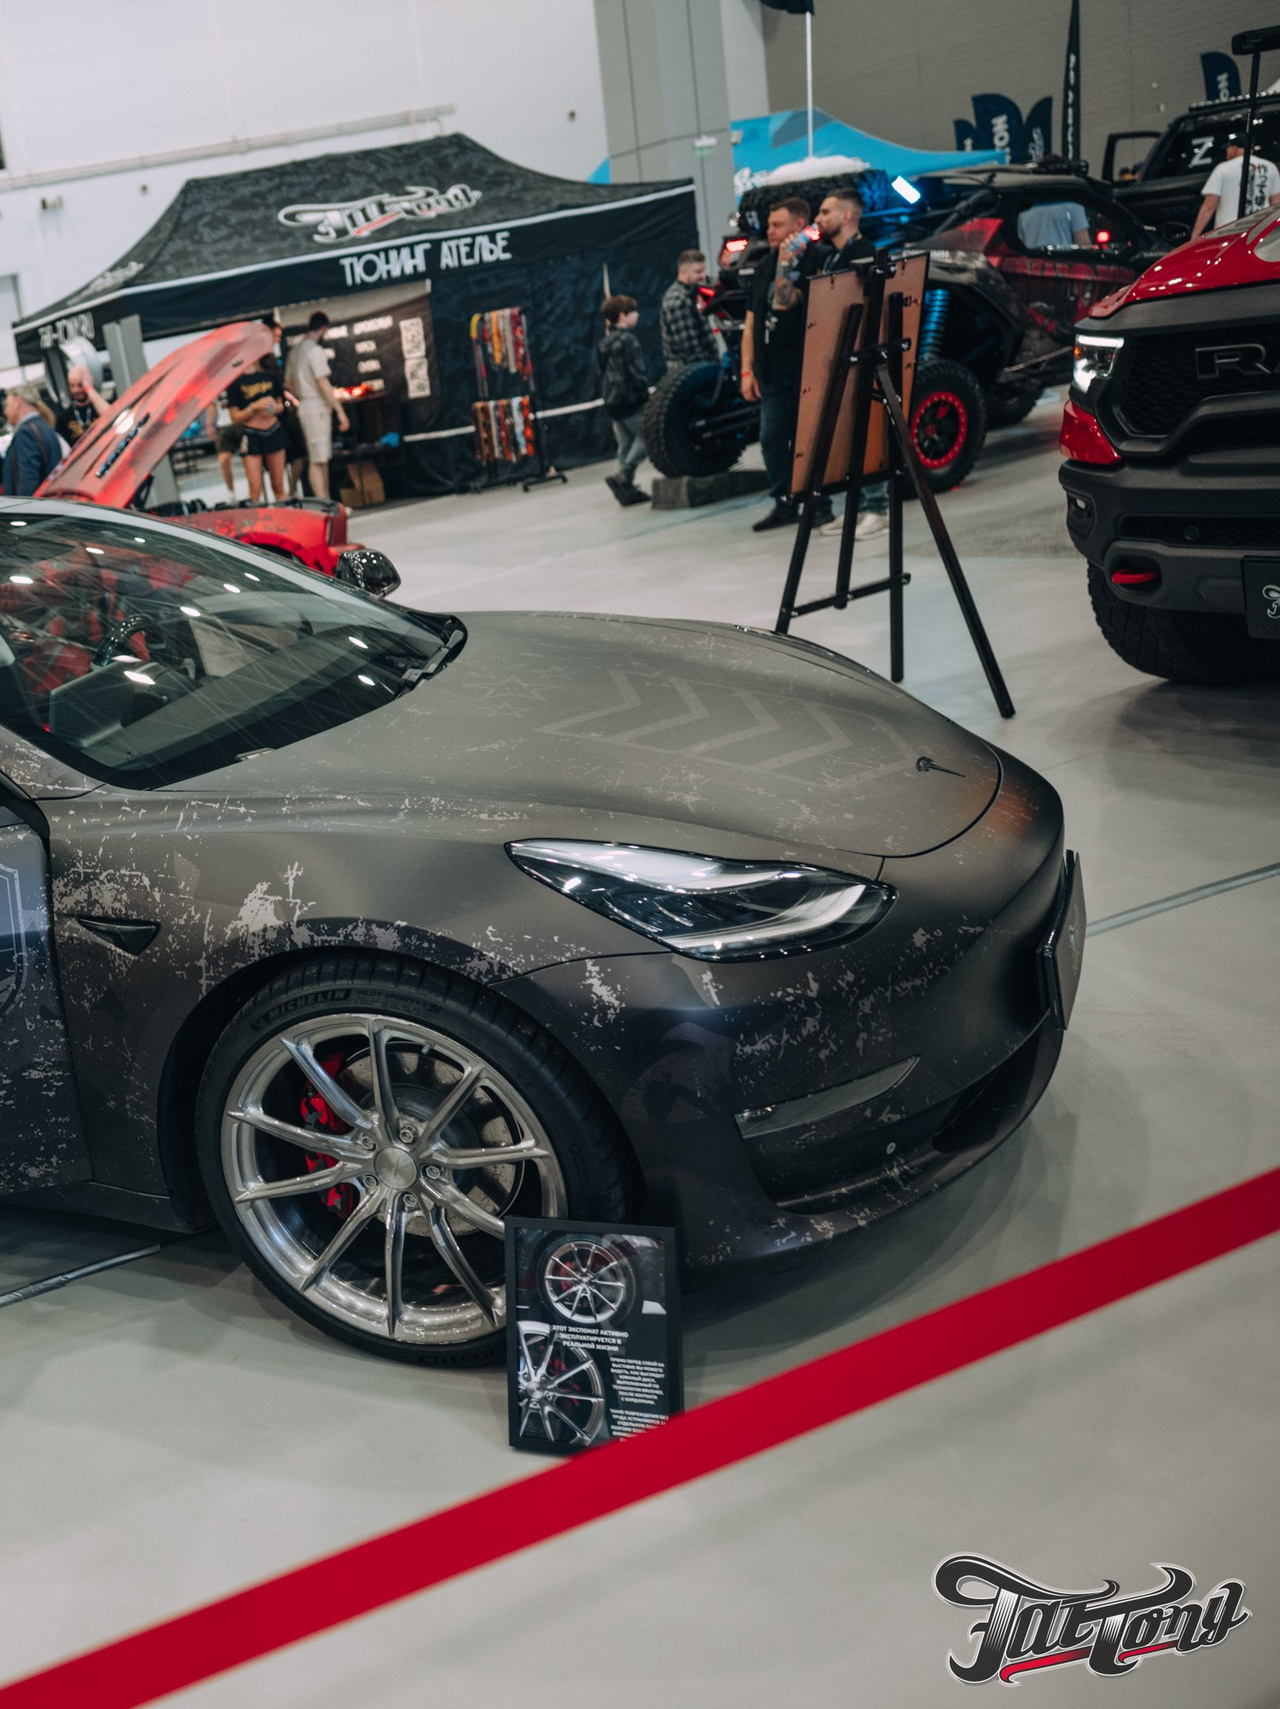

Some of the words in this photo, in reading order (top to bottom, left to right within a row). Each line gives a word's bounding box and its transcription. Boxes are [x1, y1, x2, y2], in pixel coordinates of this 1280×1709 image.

[339, 242, 432, 287] ТЮНИНГ
[439, 231, 513, 270] АТЕЛЬЕ
[268, 989, 346, 1020] MICHELIN
[568, 1326, 599, 1335] ЭКСПОНАТ
[600, 1329, 629, 1338] АКТИВНО
[562, 1340, 595, 1349] РЕАЛЬНОЙ
